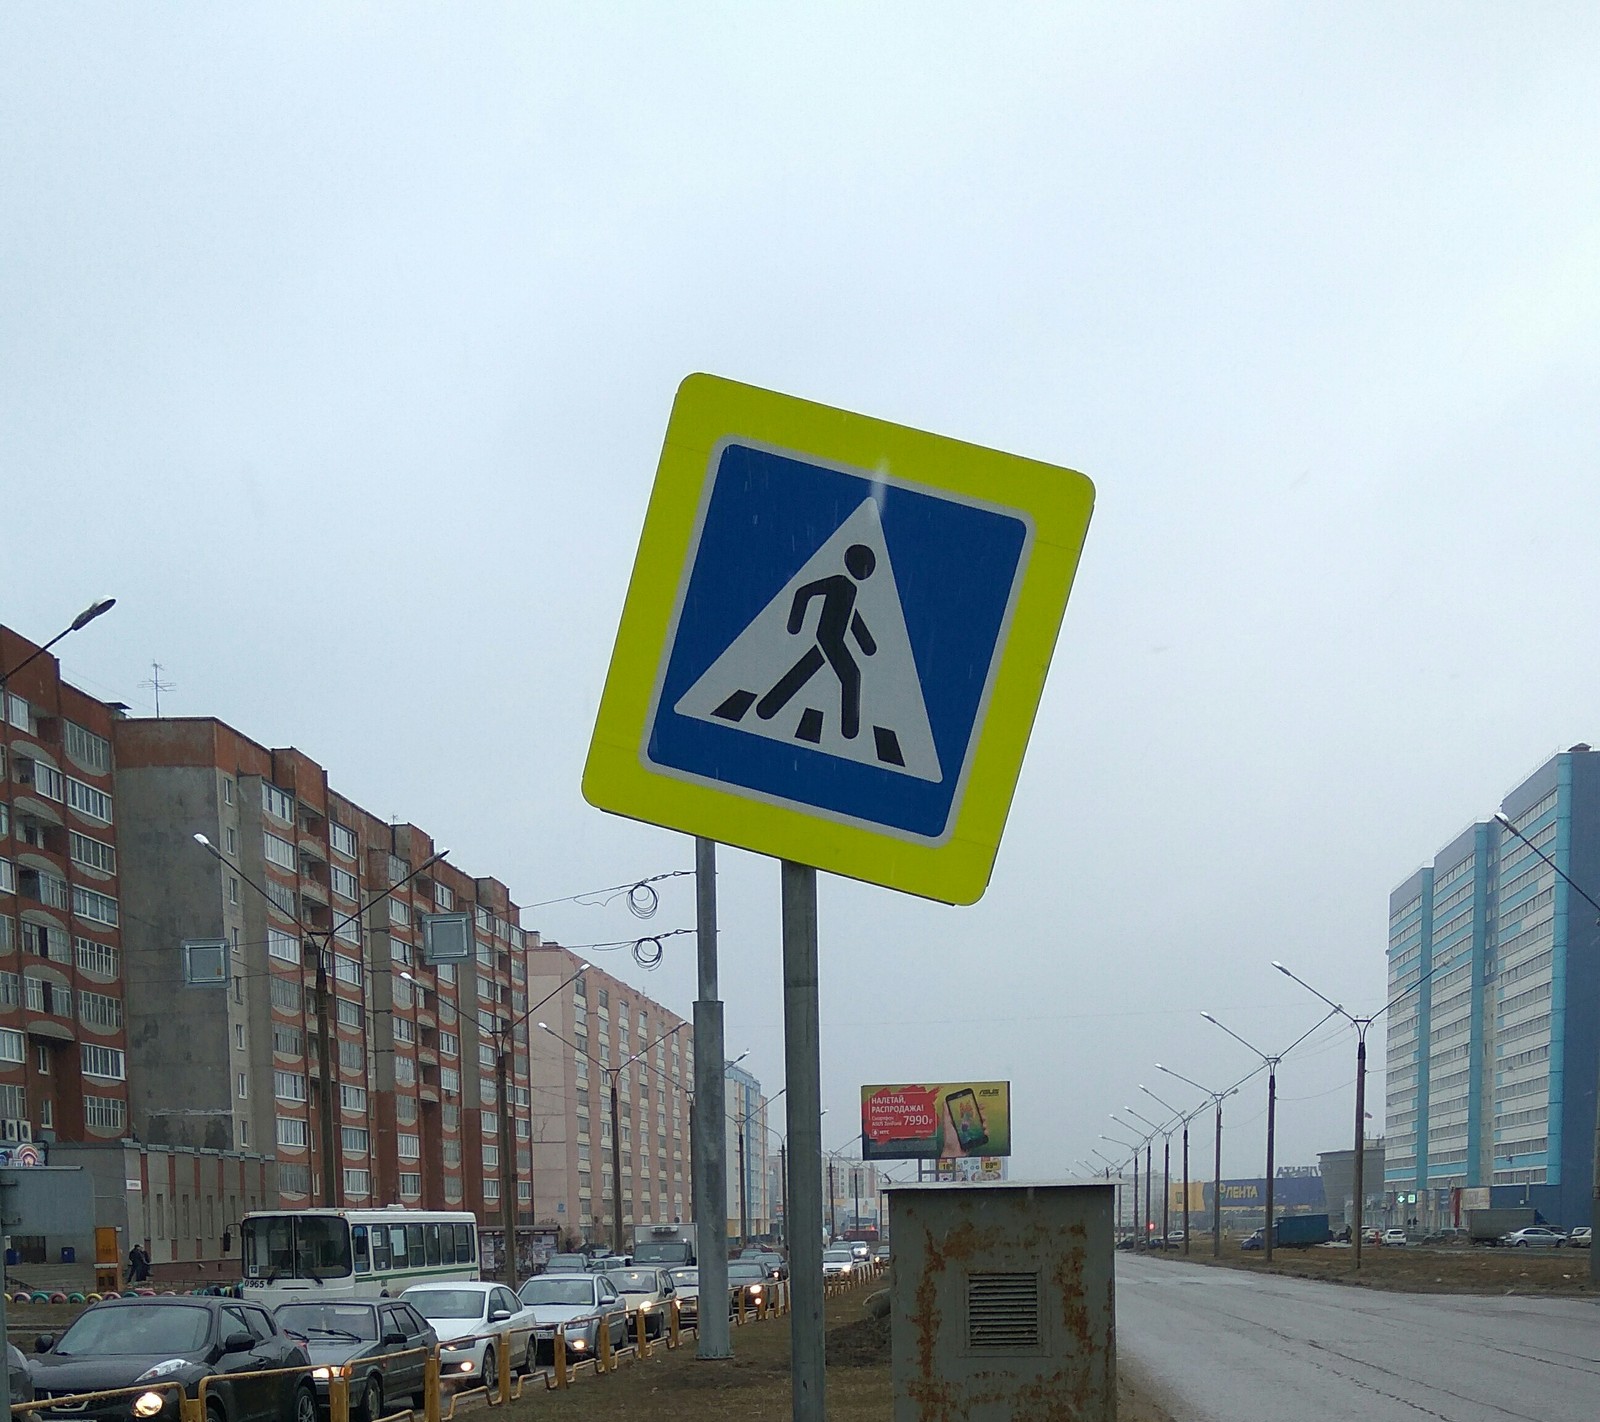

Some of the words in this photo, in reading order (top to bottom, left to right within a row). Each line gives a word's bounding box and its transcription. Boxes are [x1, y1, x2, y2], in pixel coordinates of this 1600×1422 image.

[871, 1095, 906, 1104] НАЛЕТАЙ,
[871, 1104, 924, 1113] РАСПРОДАЖА!
[903, 1115, 929, 1126] 7990
[1226, 1186, 1258, 1198] ЛЕНТА
[245, 1280, 264, 1288] 0965
